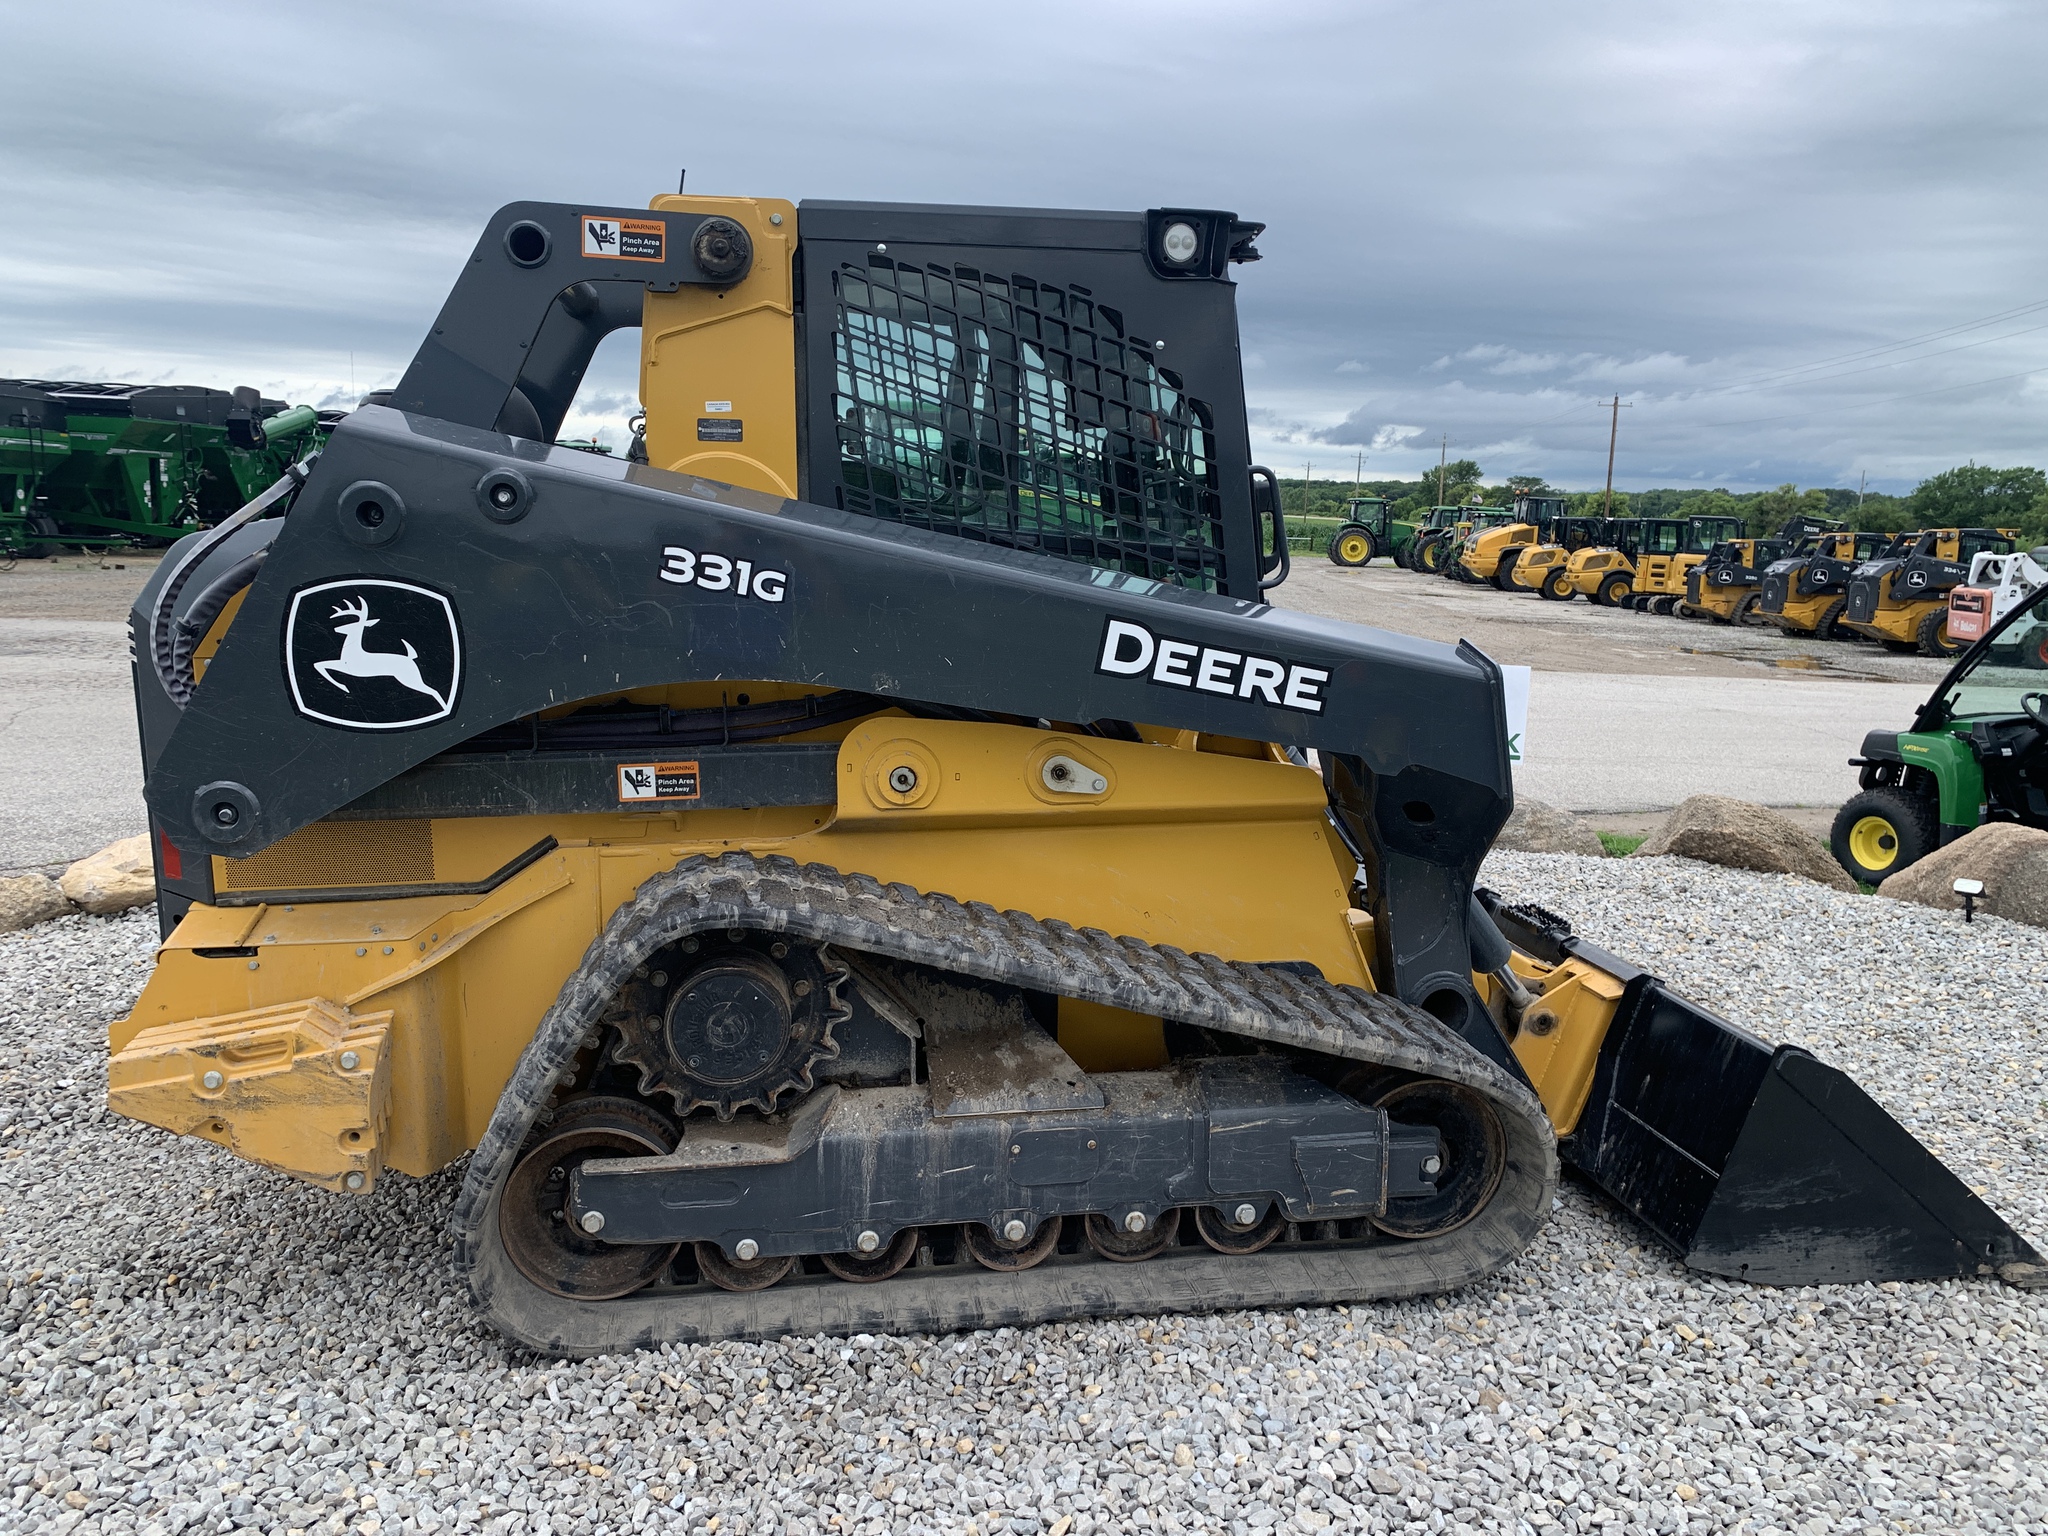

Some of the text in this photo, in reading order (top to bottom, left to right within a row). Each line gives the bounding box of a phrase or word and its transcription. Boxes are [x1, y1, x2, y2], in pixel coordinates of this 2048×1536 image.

[629, 222, 661, 231] WARNING
[622, 236, 660, 246] Pinch Area
[622, 245, 655, 255] Keep Away
[659, 546, 788, 603] 331G
[1100, 619, 1329, 712] DEERE
